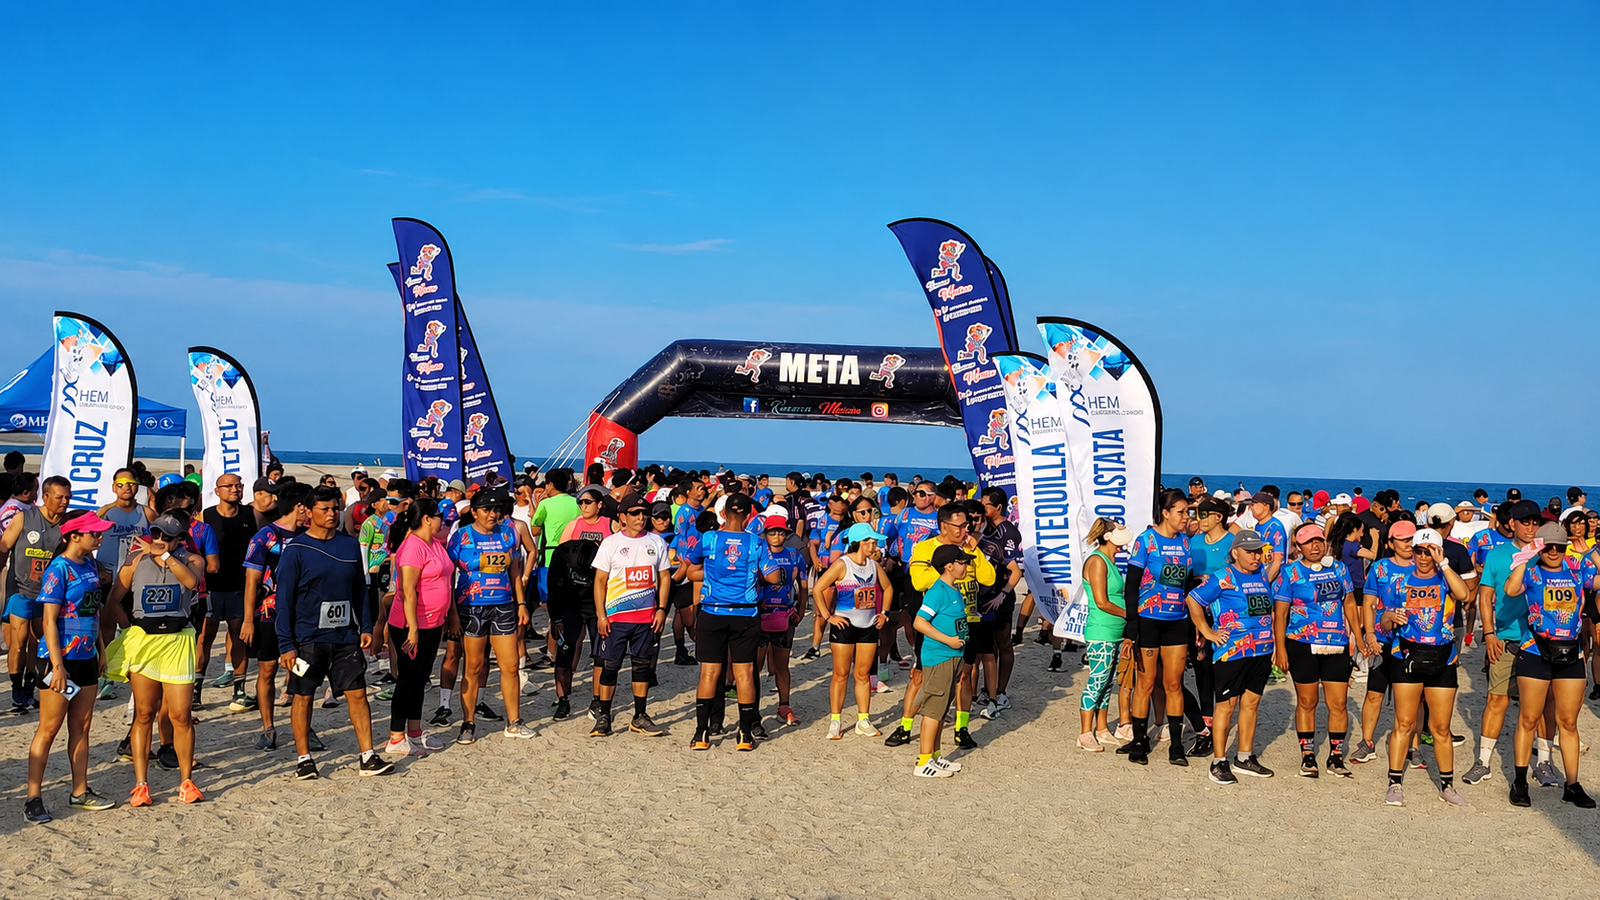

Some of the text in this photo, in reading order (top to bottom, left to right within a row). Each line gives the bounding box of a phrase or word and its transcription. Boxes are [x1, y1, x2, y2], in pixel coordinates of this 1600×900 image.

[779, 352, 860, 385] META
[80, 389, 109, 403] HEM
[1088, 395, 1120, 409] HEM
[1030, 416, 1062, 429] HEM
[70, 421, 108, 482] CRUZ
[1092, 428, 1127, 500] ASTATA
[1031, 443, 1072, 585] MIXTEQUILLA
[486, 555, 506, 566] 122
[627, 569, 650, 582] 406
[1163, 564, 1187, 579] 026
[146, 588, 173, 604] 221
[857, 590, 875, 602] 915
[1548, 589, 1573, 602] 109
[327, 604, 346, 618] 601
